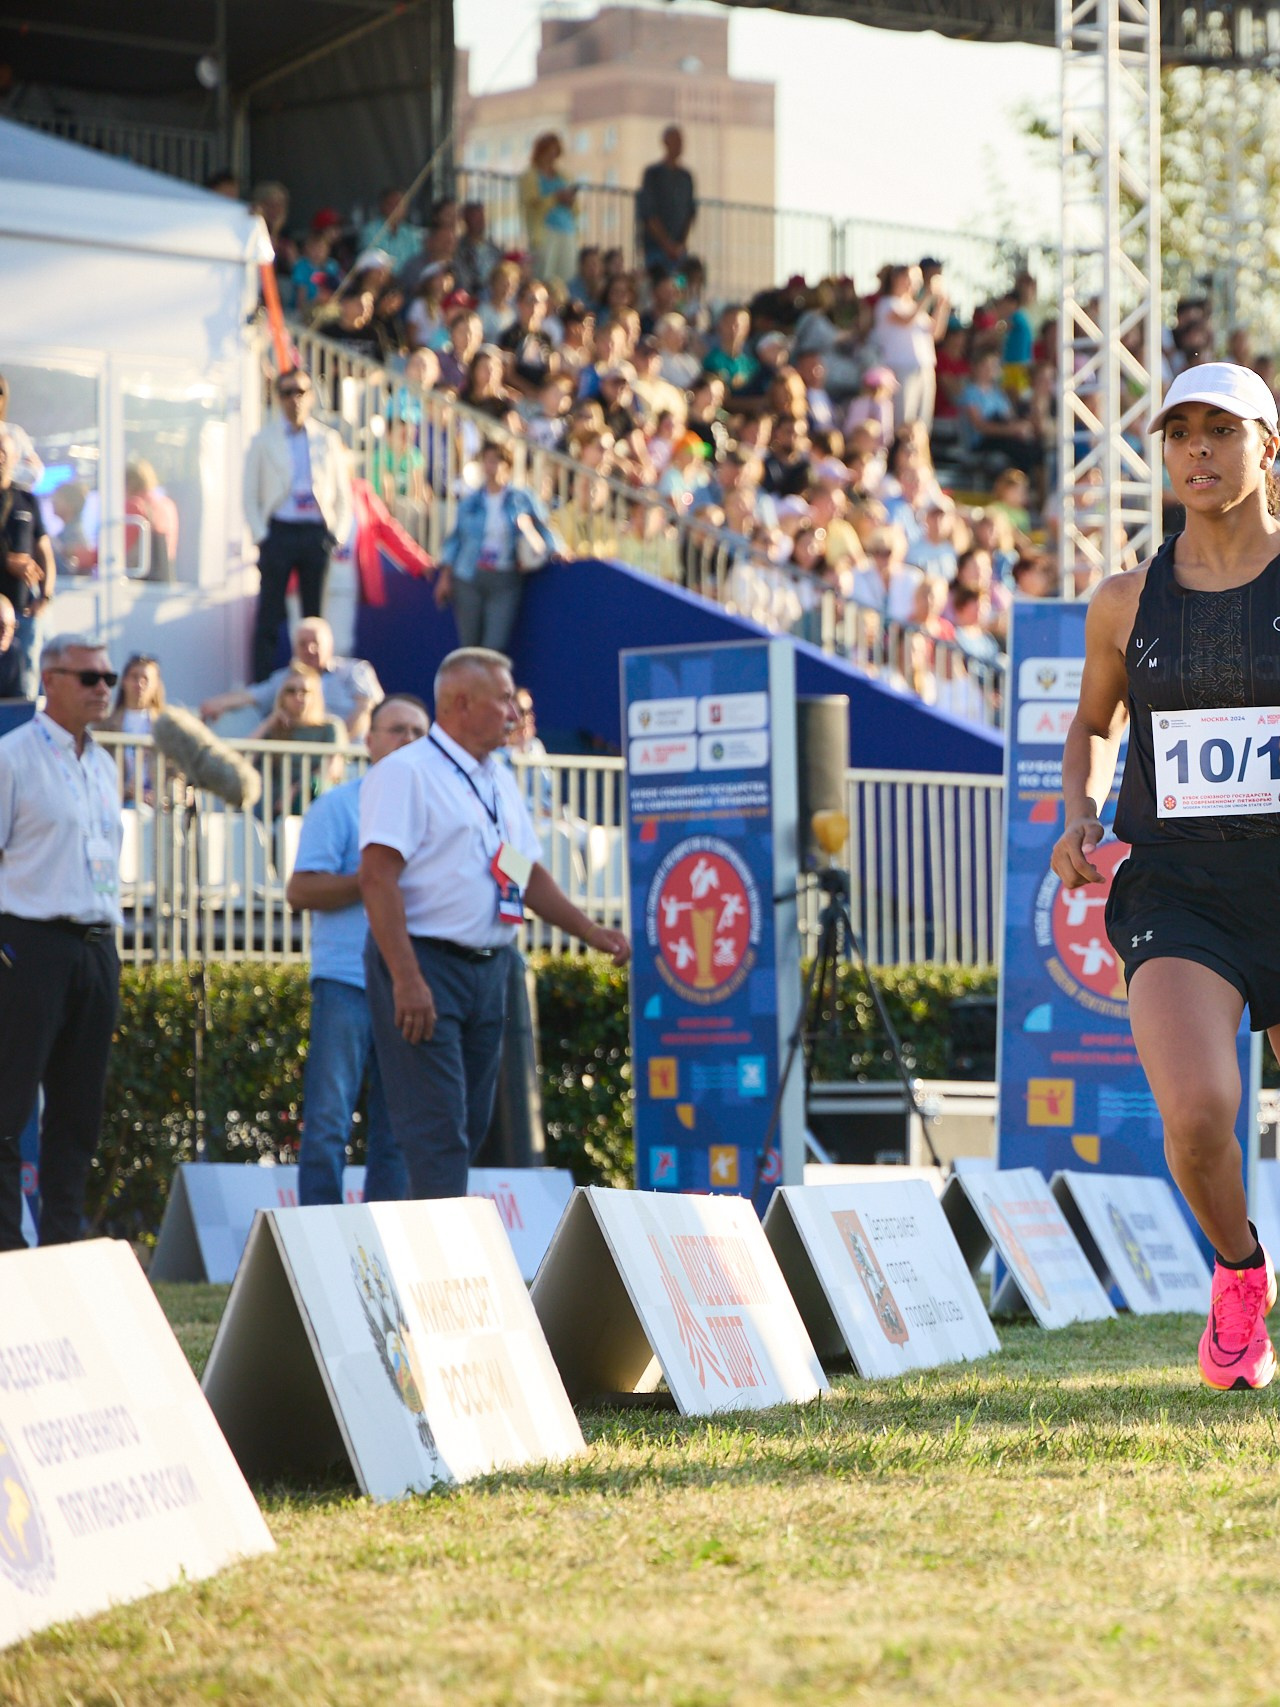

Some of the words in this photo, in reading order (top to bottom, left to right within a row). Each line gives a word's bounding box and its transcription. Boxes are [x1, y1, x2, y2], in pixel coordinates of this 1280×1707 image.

[408, 1275, 499, 1334] МИНСПОРТ
[0, 1336, 87, 1394] ЕДЕРАЦИЯ
[705, 1315, 768, 1389] СПОРТ
[439, 1358, 513, 1419] РОССИИ
[22, 1403, 141, 1468] СОВРЕМЕННОГО
